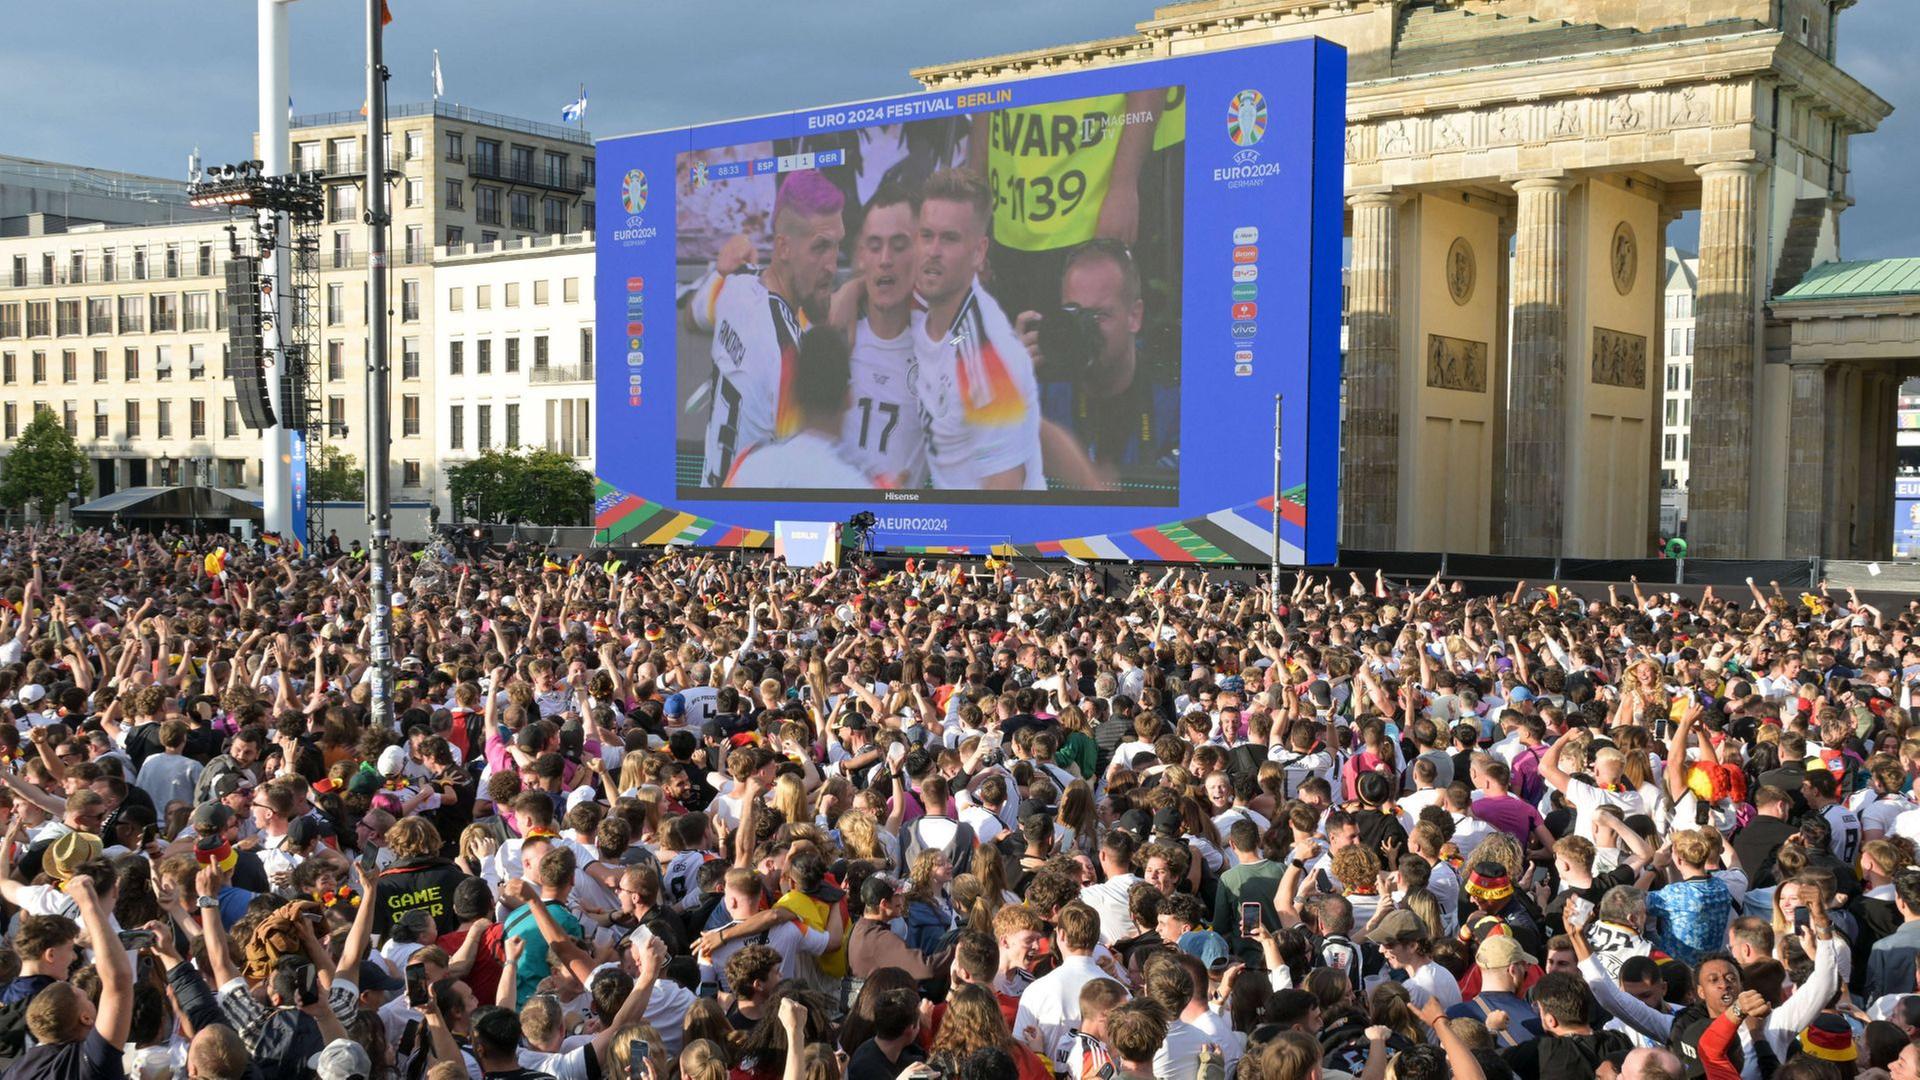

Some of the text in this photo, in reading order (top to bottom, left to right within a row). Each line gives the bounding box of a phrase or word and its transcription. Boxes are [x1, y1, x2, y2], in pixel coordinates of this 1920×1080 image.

[808, 89, 1012, 129] EURO 2024 FESTIVAL BERLIN
[1100, 111, 1154, 127] MAGENTA
[1101, 129, 1116, 141] TV
[756, 161, 775, 172] ESP
[783, 159, 789, 168] 1
[801, 157, 807, 166] 1
[818, 153, 838, 164] GER
[1233, 150, 1259, 164] UEFA
[1213, 162, 1281, 181] EURO2024
[1228, 178, 1265, 189] GERMANY
[614, 227, 657, 241] EURO2024
[1232, 326, 1257, 334] vivo
[855, 397, 900, 453] 17
[885, 492, 919, 501] Hisense
[867, 516, 948, 531] FAEURO2024
[388, 887, 441, 908] GAME
[391, 903, 444, 924] OR
